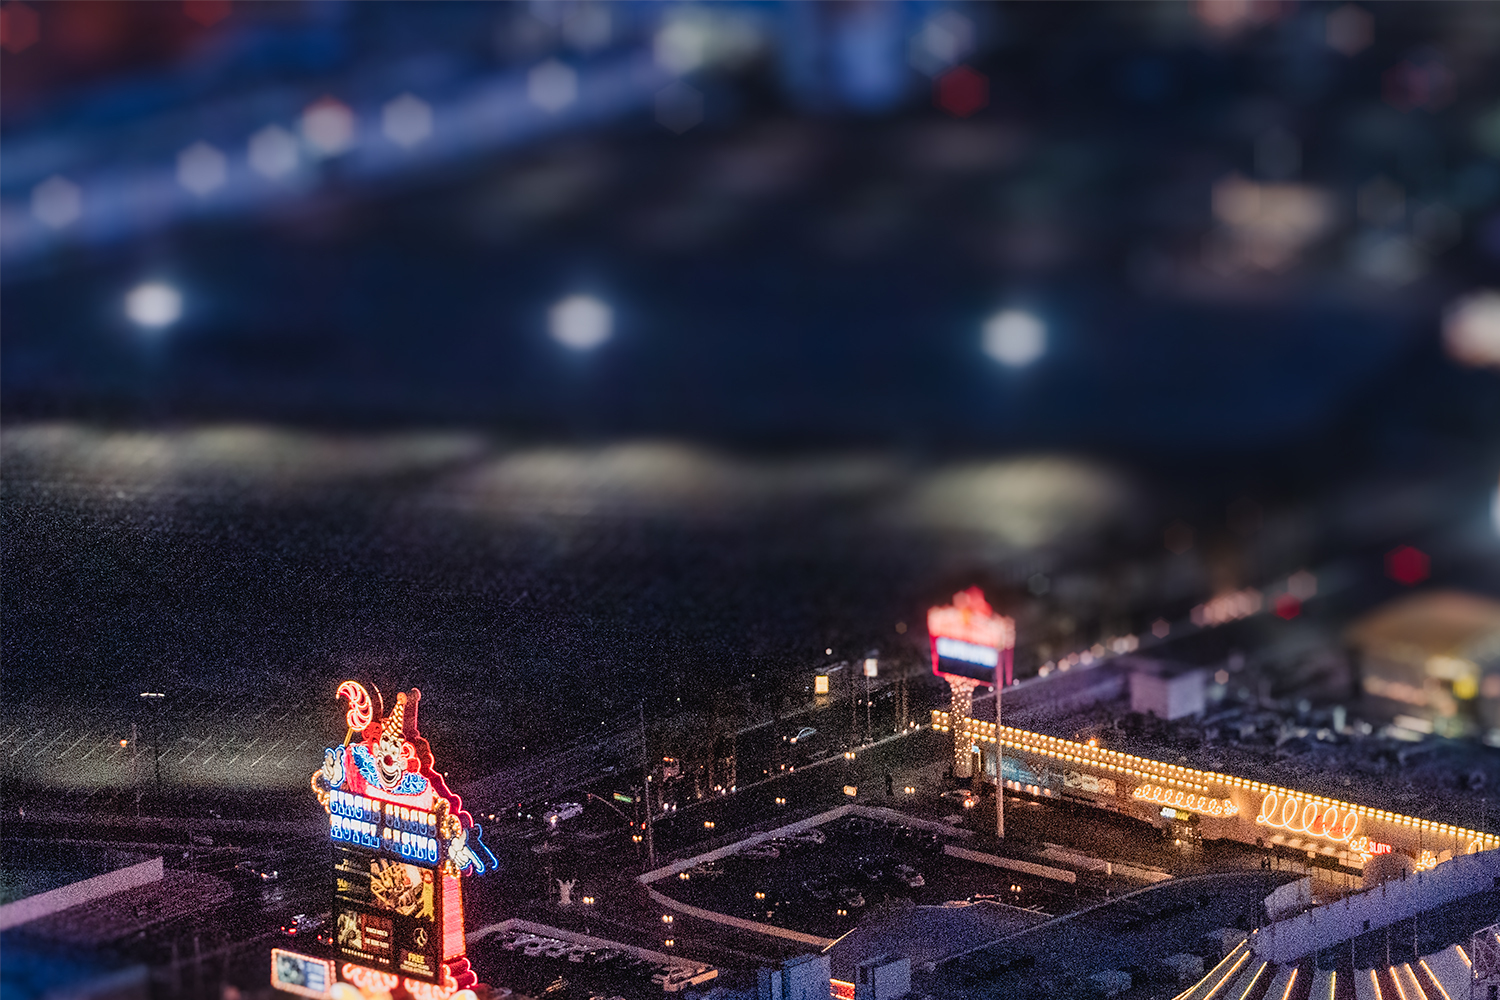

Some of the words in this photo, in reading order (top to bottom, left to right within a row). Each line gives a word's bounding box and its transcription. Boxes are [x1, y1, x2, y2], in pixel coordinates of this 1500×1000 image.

[330, 789, 381, 824] CIRCUS
[385, 803, 437, 838] CIRCUS
[330, 814, 380, 848] HOTEL
[383, 827, 438, 862] CASINO
[408, 952, 425, 964] FREE
